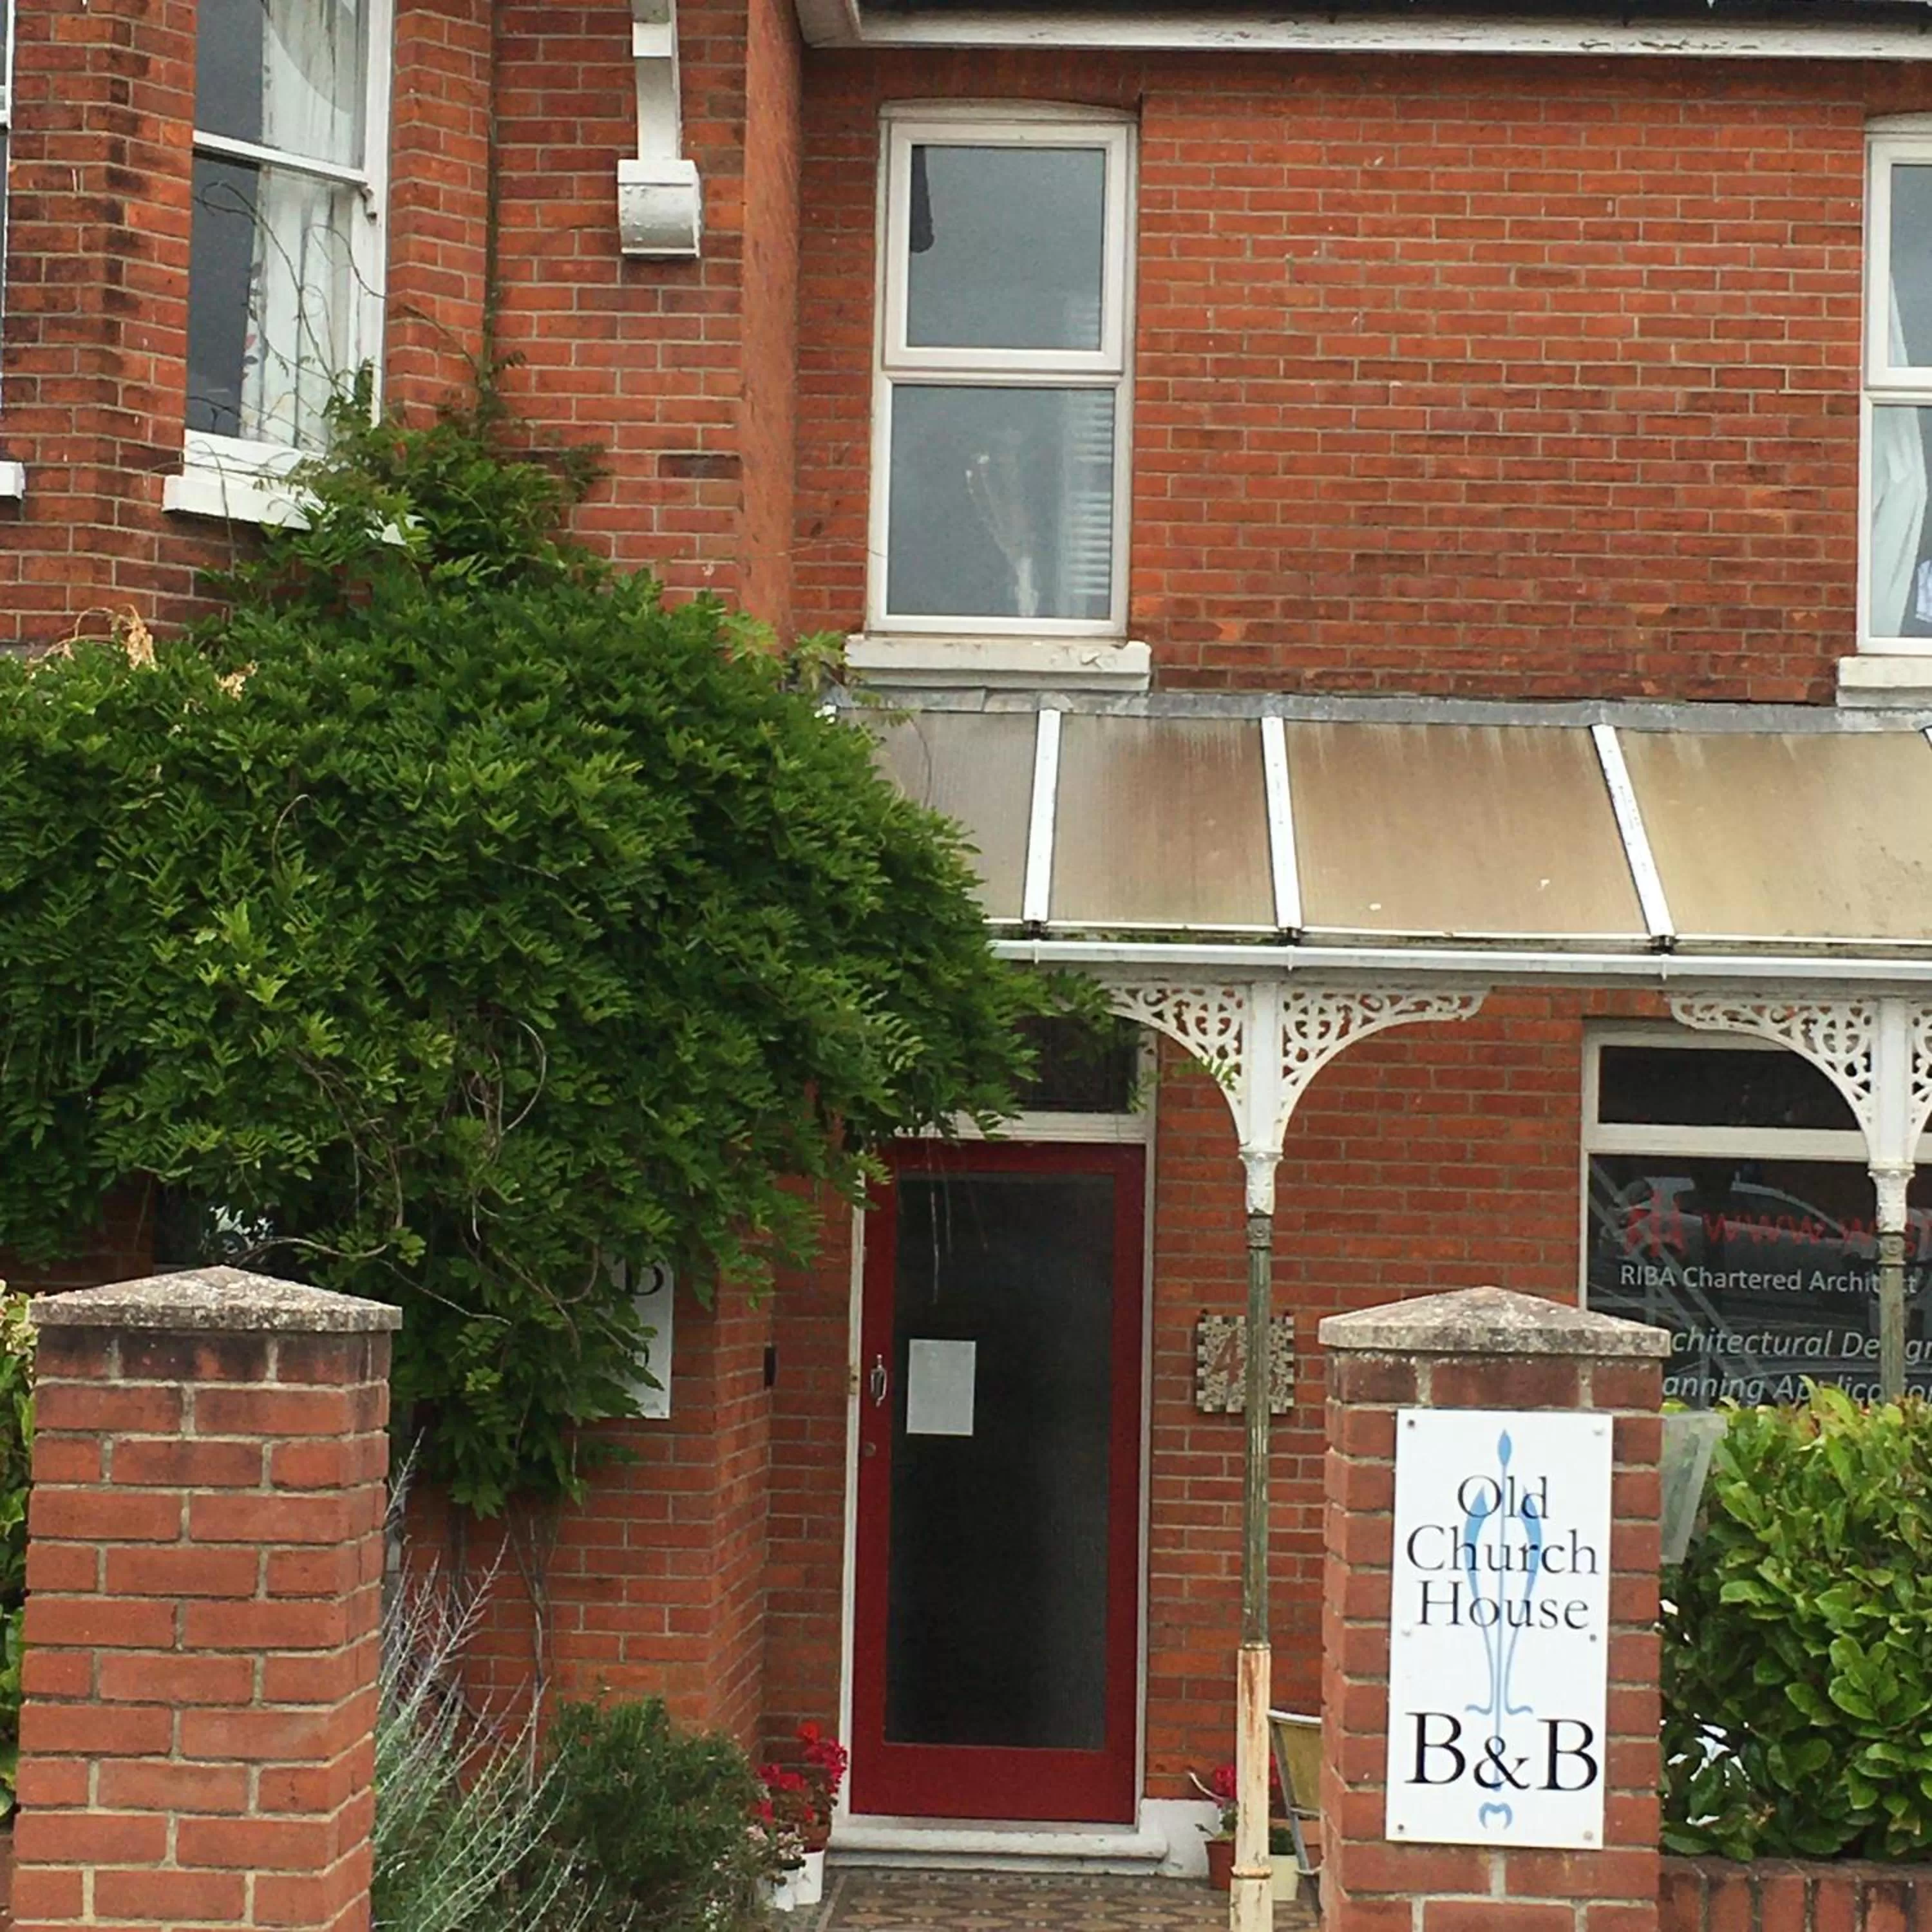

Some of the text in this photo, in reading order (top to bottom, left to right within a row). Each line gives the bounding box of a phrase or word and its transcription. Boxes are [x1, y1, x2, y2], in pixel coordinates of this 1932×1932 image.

[1620, 1264, 1918, 1294] RIBA Chartered Architt
[1671, 1324, 1834, 1358] chitectural
[1662, 1371, 1765, 1406] anning
[1457, 1474, 1549, 1520] Old
[1406, 1524, 1599, 1575] Church
[1416, 1580, 1589, 1629] House
[1404, 1712, 1598, 1792] B&B
